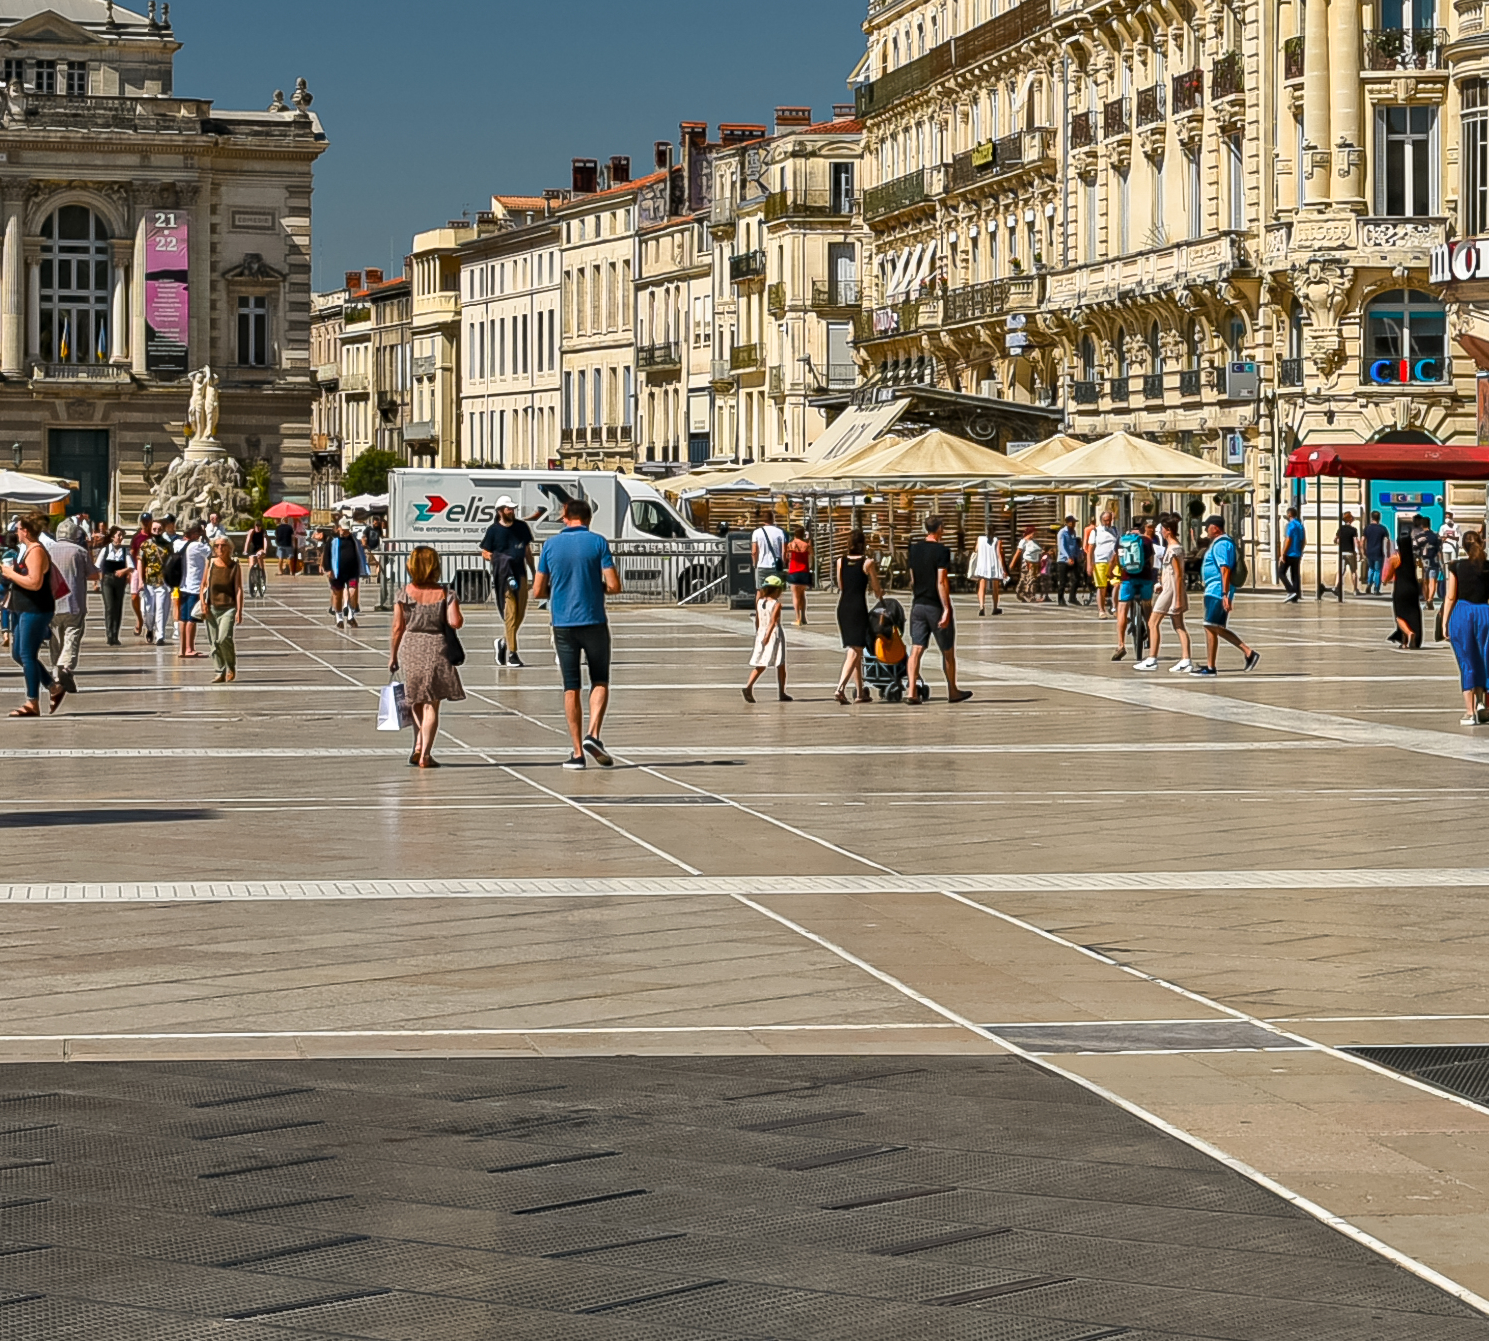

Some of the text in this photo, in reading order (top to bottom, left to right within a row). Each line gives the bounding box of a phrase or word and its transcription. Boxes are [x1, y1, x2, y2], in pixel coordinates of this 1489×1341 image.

[154, 212, 178, 228] 21
[155, 236, 178, 251] 22
[1233, 363, 1253, 373] CIC
[1369, 358, 1438, 383] CIC
[445, 495, 496, 523] elis
[412, 525, 425, 533] We
[425, 526, 462, 535] empower
